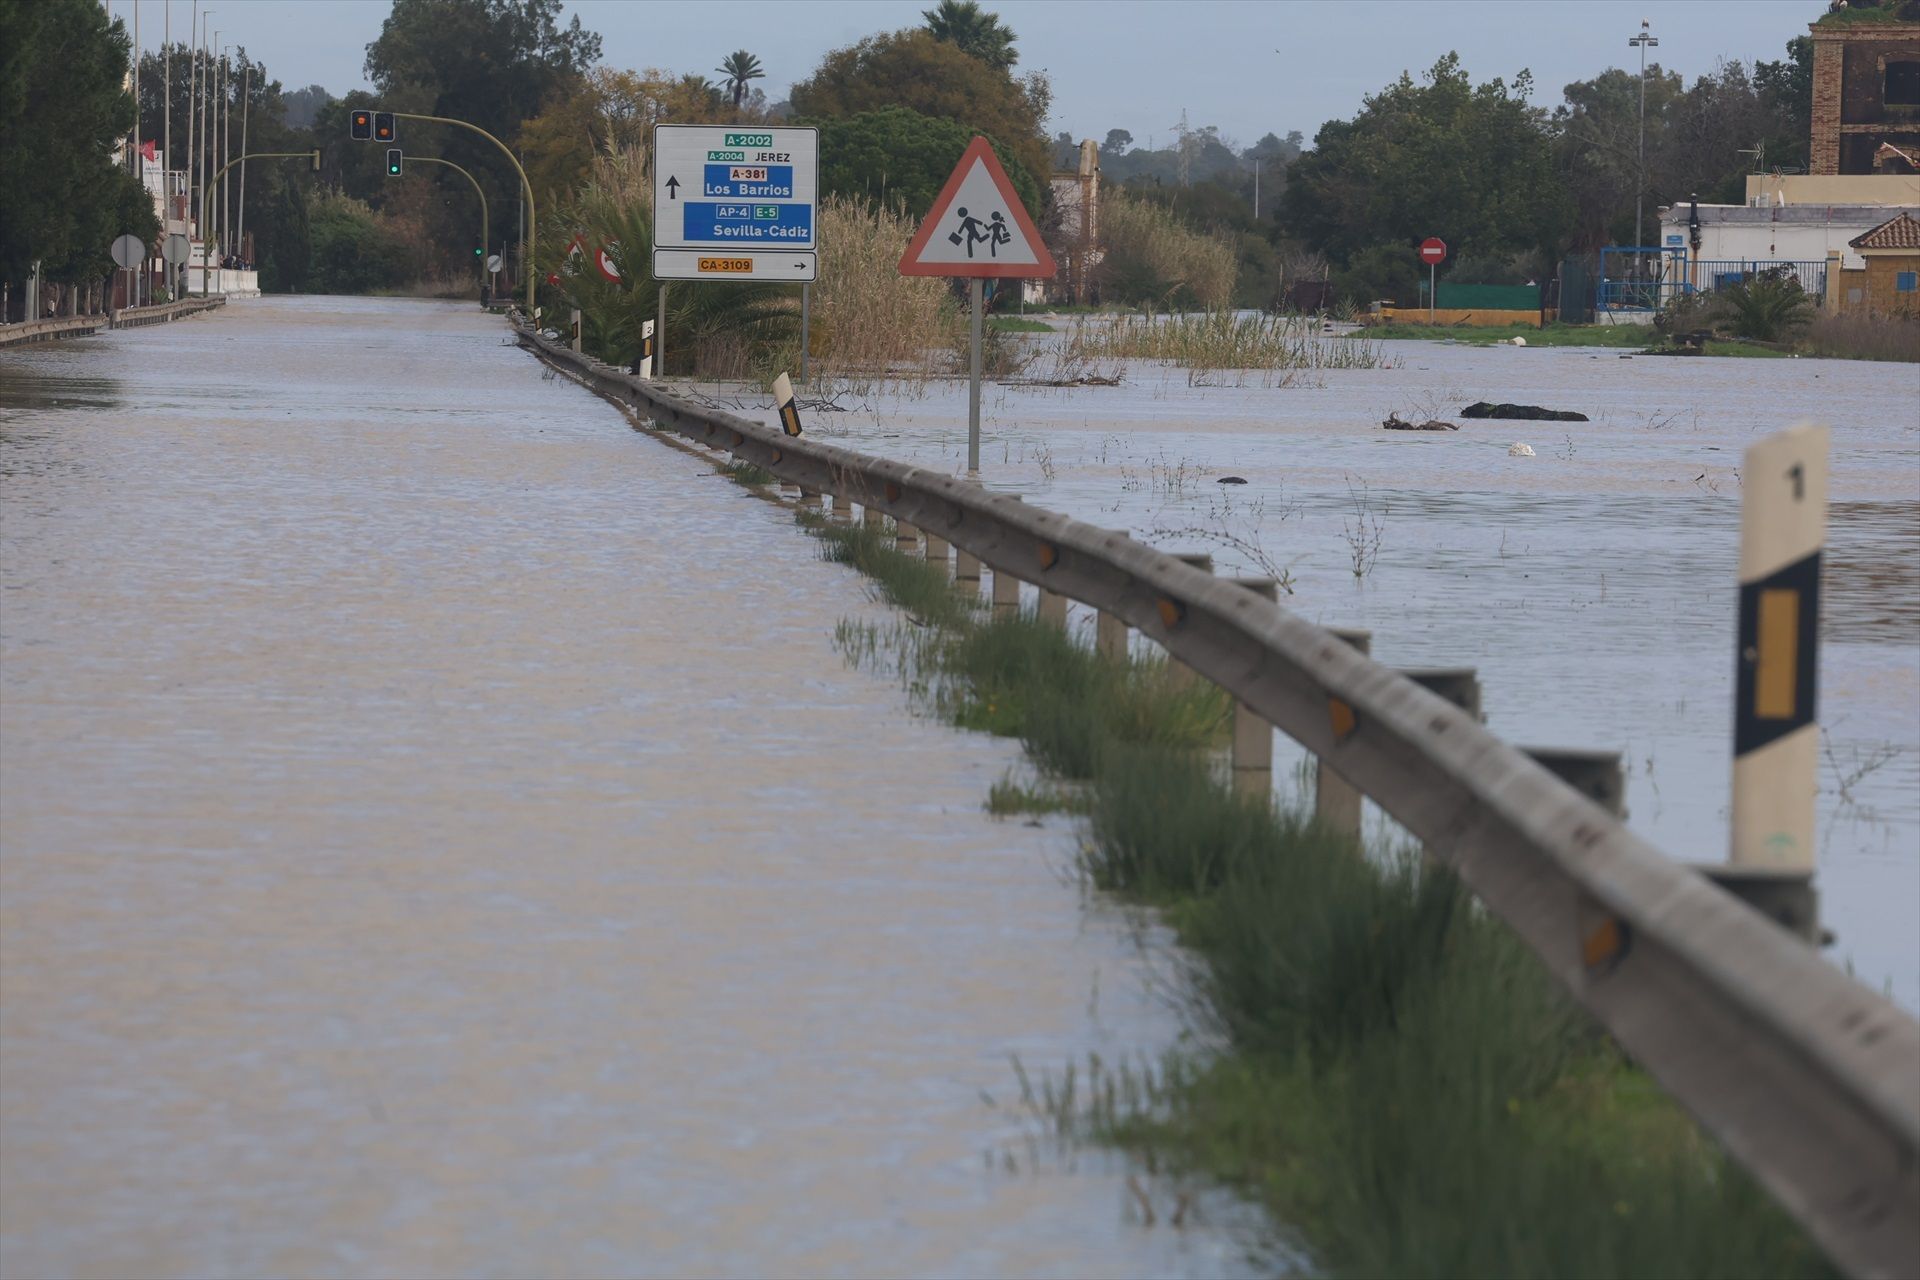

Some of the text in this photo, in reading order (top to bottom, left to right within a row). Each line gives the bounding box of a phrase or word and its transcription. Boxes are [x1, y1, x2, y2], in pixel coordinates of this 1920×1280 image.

[727, 135, 771, 146] A-2002
[709, 152, 790, 162] A-2004 JEREZ
[732, 169, 765, 179] A-381
[706, 183, 790, 196] Los Barrios
[719, 206, 776, 218] AP-4 E-5
[713, 224, 808, 238] Sevilla-Cádiz
[700, 260, 750, 270] CA-3109
